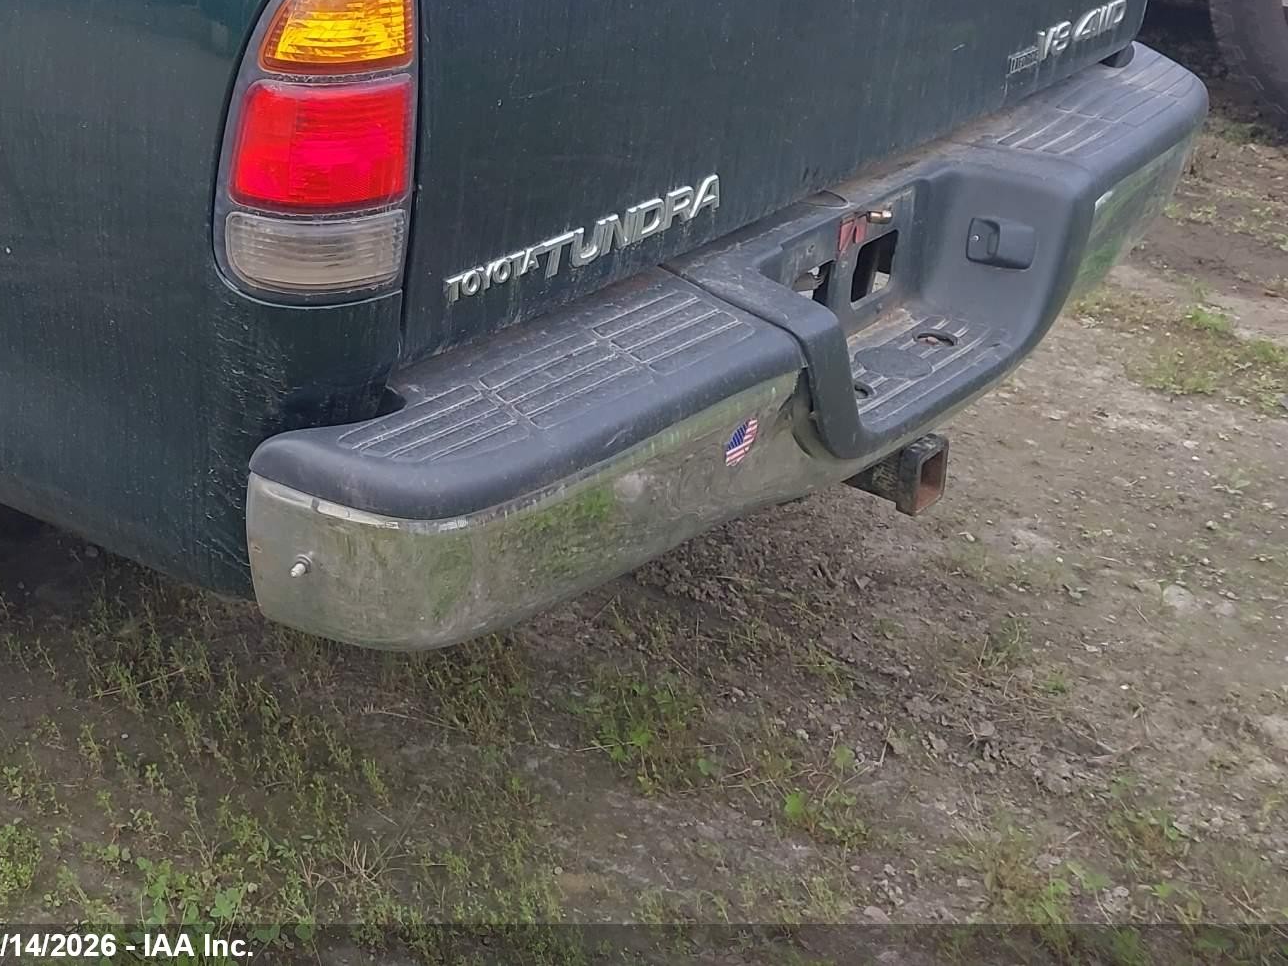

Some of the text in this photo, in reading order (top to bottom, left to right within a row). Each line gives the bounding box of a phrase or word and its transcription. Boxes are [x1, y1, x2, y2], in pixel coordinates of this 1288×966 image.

[1037, 20, 1072, 62] V8
[444, 173, 721, 306] TOYOTA TUNDRA
